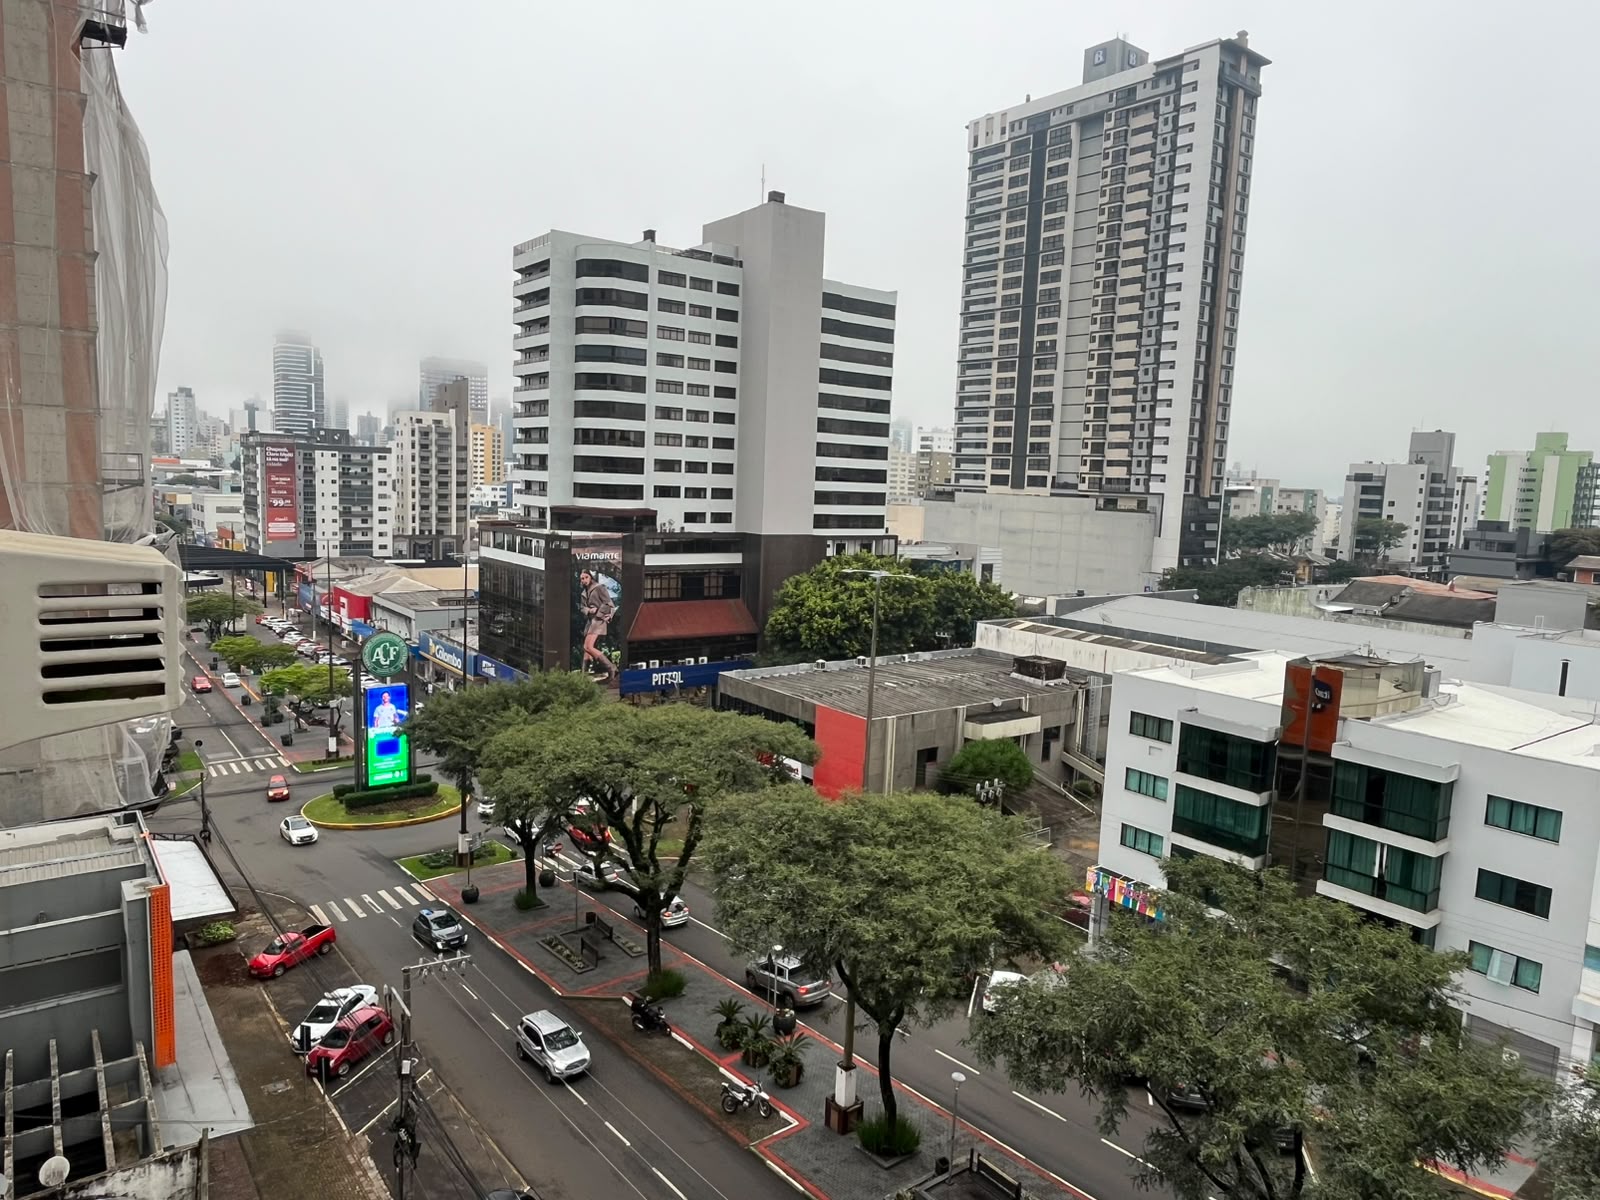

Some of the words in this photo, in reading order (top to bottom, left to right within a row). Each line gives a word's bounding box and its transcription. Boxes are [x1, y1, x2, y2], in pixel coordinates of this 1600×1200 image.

[1094, 51, 1104, 65] B
[435, 645, 462, 669] Colombo
[652, 671, 684, 686] PITTOL
